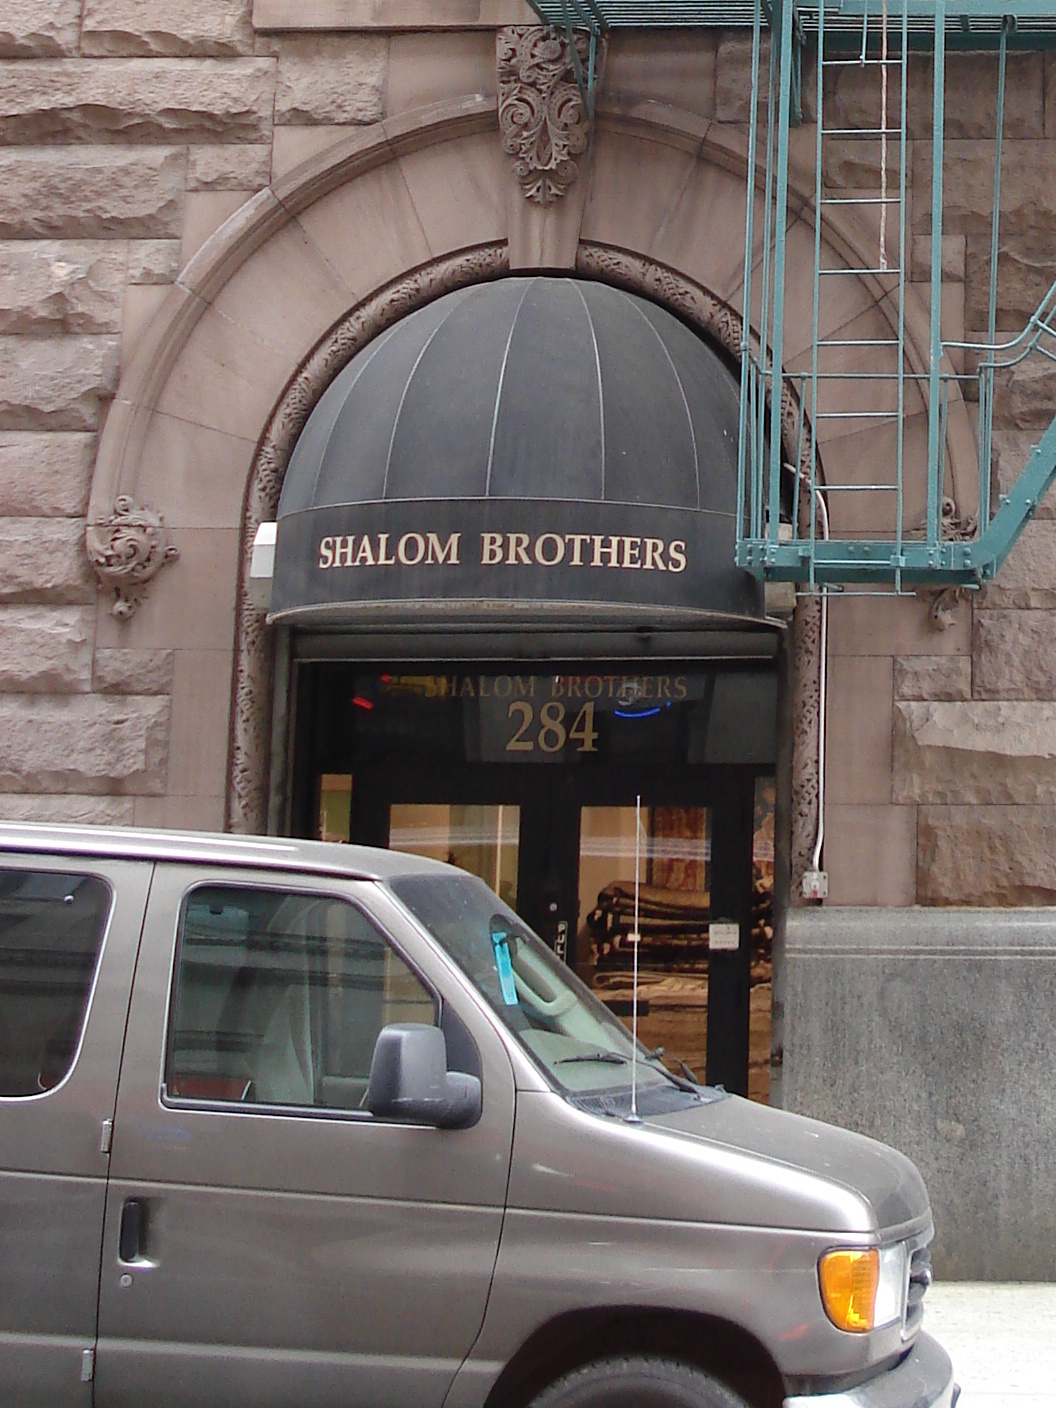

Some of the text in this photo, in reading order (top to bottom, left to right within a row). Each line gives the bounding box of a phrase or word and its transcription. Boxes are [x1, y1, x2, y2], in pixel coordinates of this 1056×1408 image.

[318, 533, 687, 572] SHALOM BROTHERS
[424, 675, 687, 698] SHALOM BROTHERS
[506, 700, 598, 752] 284
